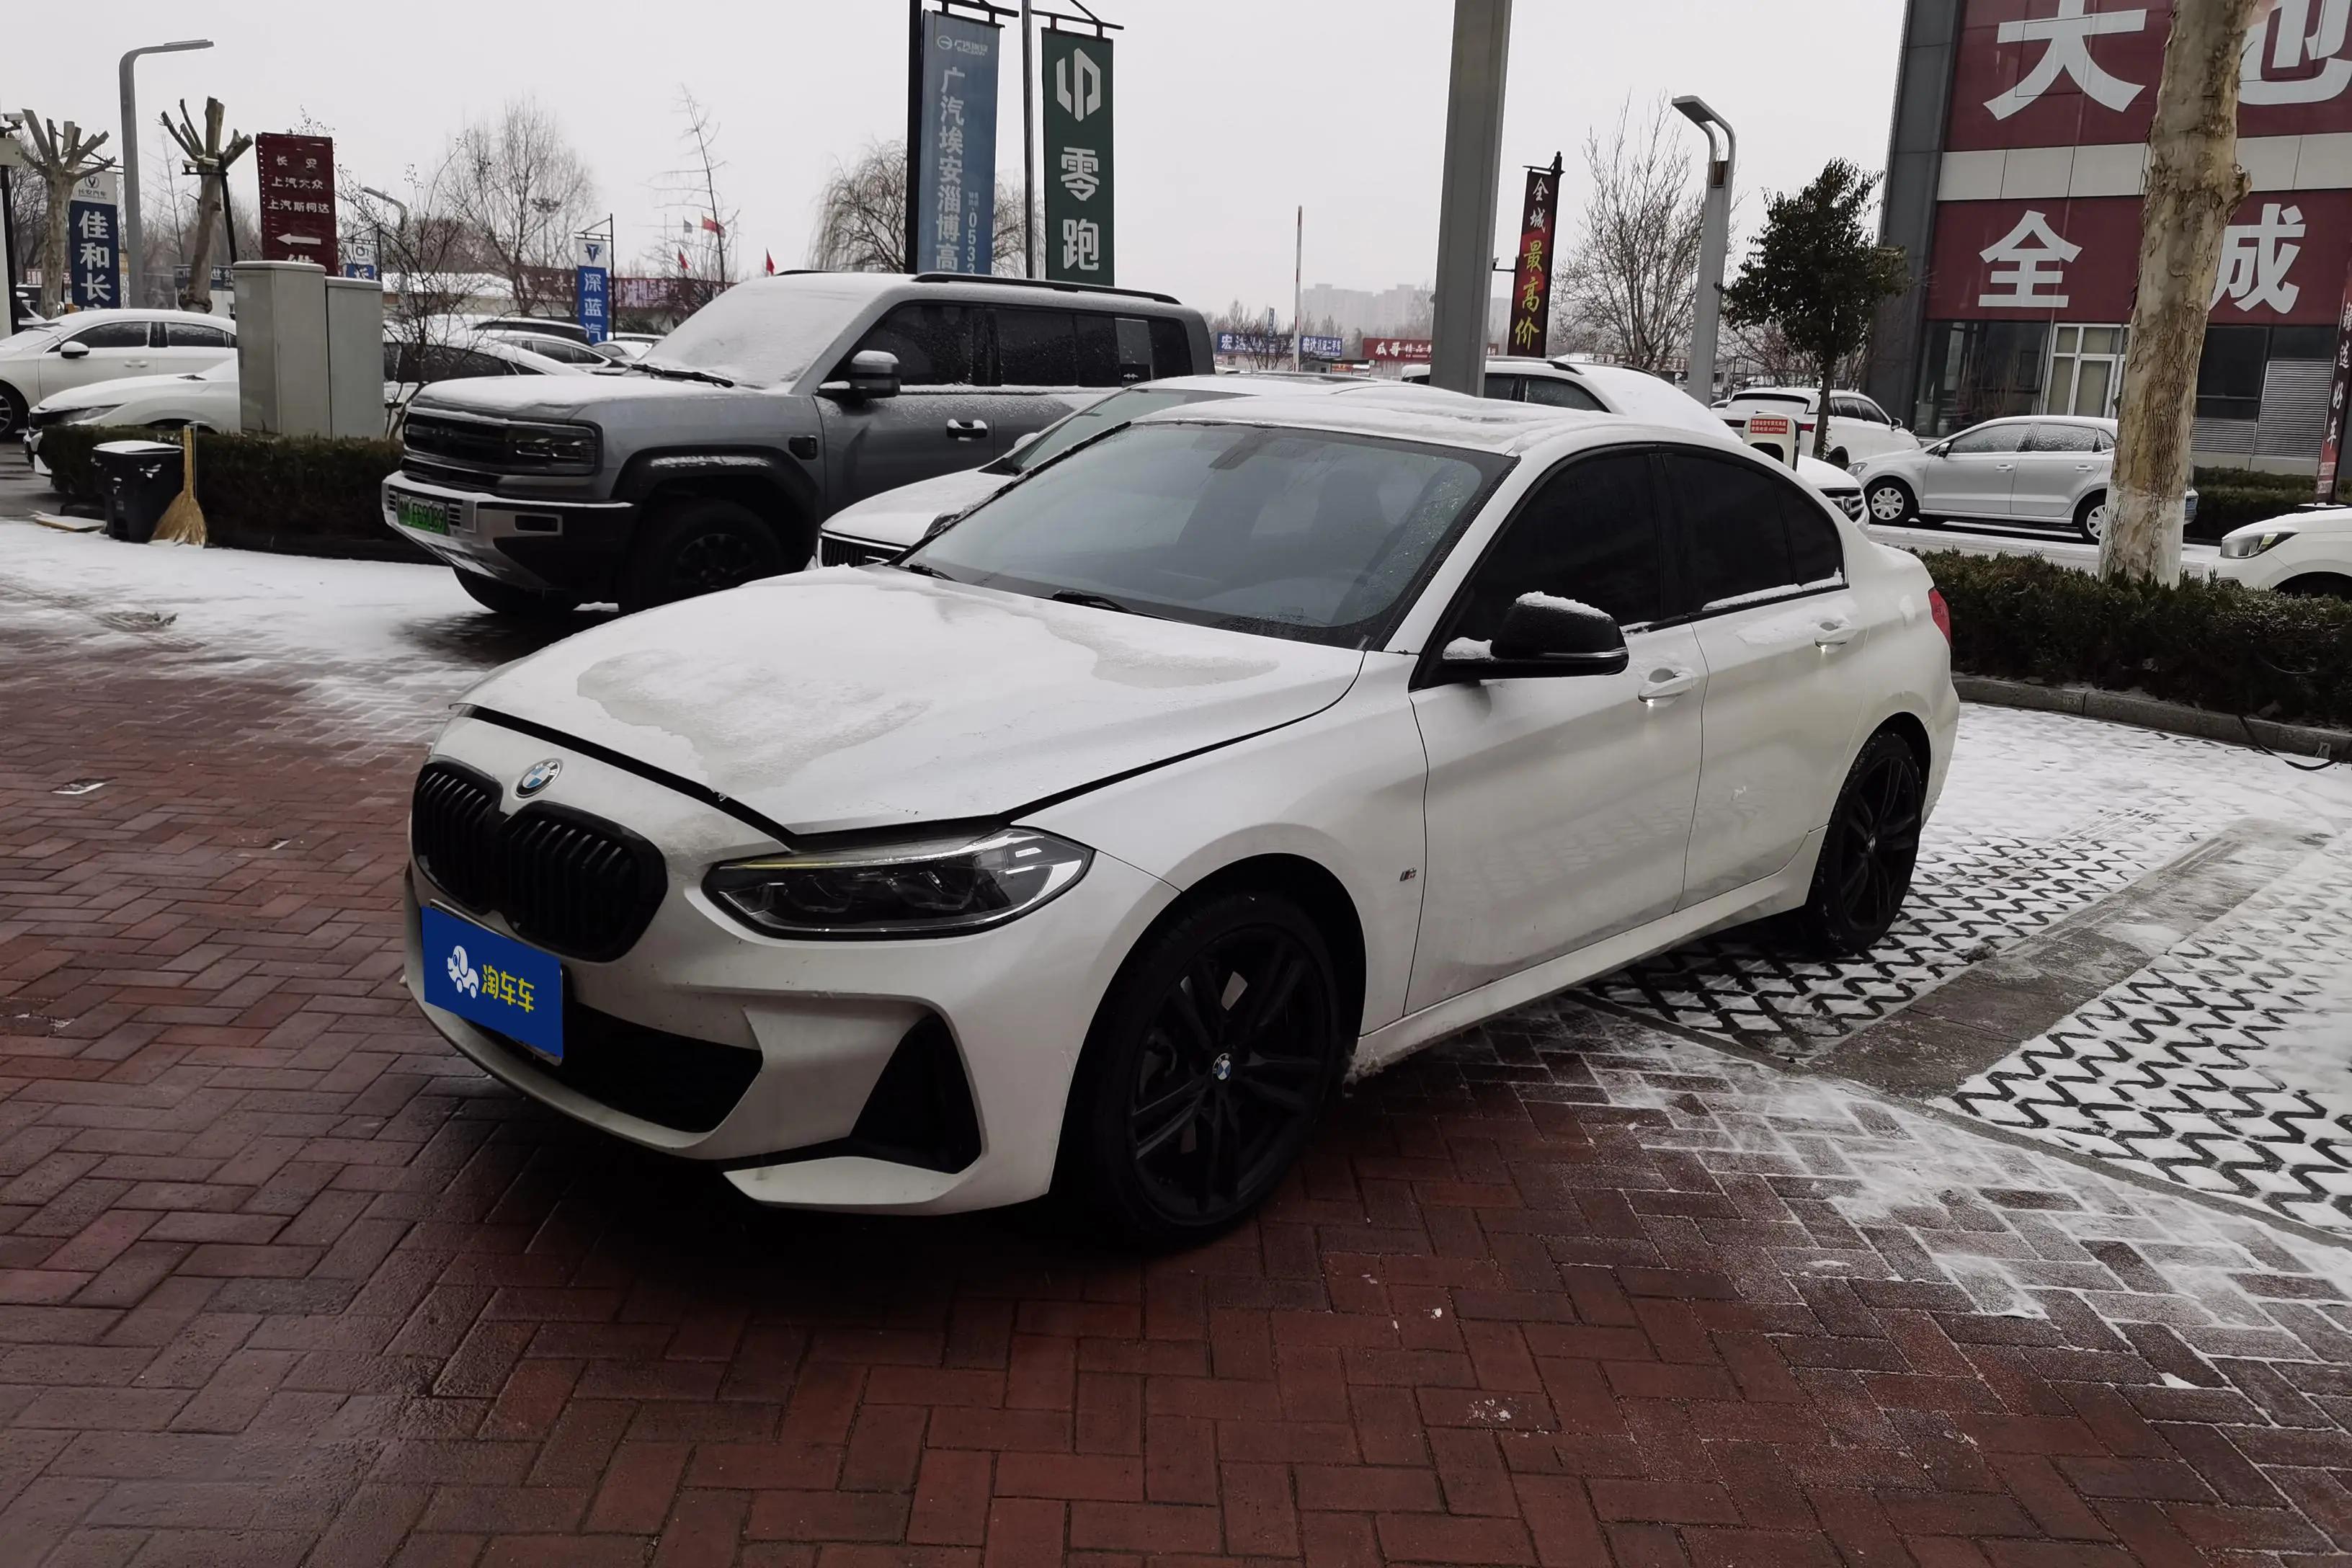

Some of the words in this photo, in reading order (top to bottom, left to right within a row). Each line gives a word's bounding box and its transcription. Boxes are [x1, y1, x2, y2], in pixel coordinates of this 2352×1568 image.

[267, 199, 330, 214] 上汽斯柯达
[271, 177, 324, 190] 上汽大众
[935, 67, 965, 271] 广汽埃安淄博高
[1061, 146, 1100, 271] 零跑
[78, 209, 112, 311] 佳和长
[584, 272, 603, 342] 深蓝汽
[1515, 177, 1549, 350] 全城最高价
